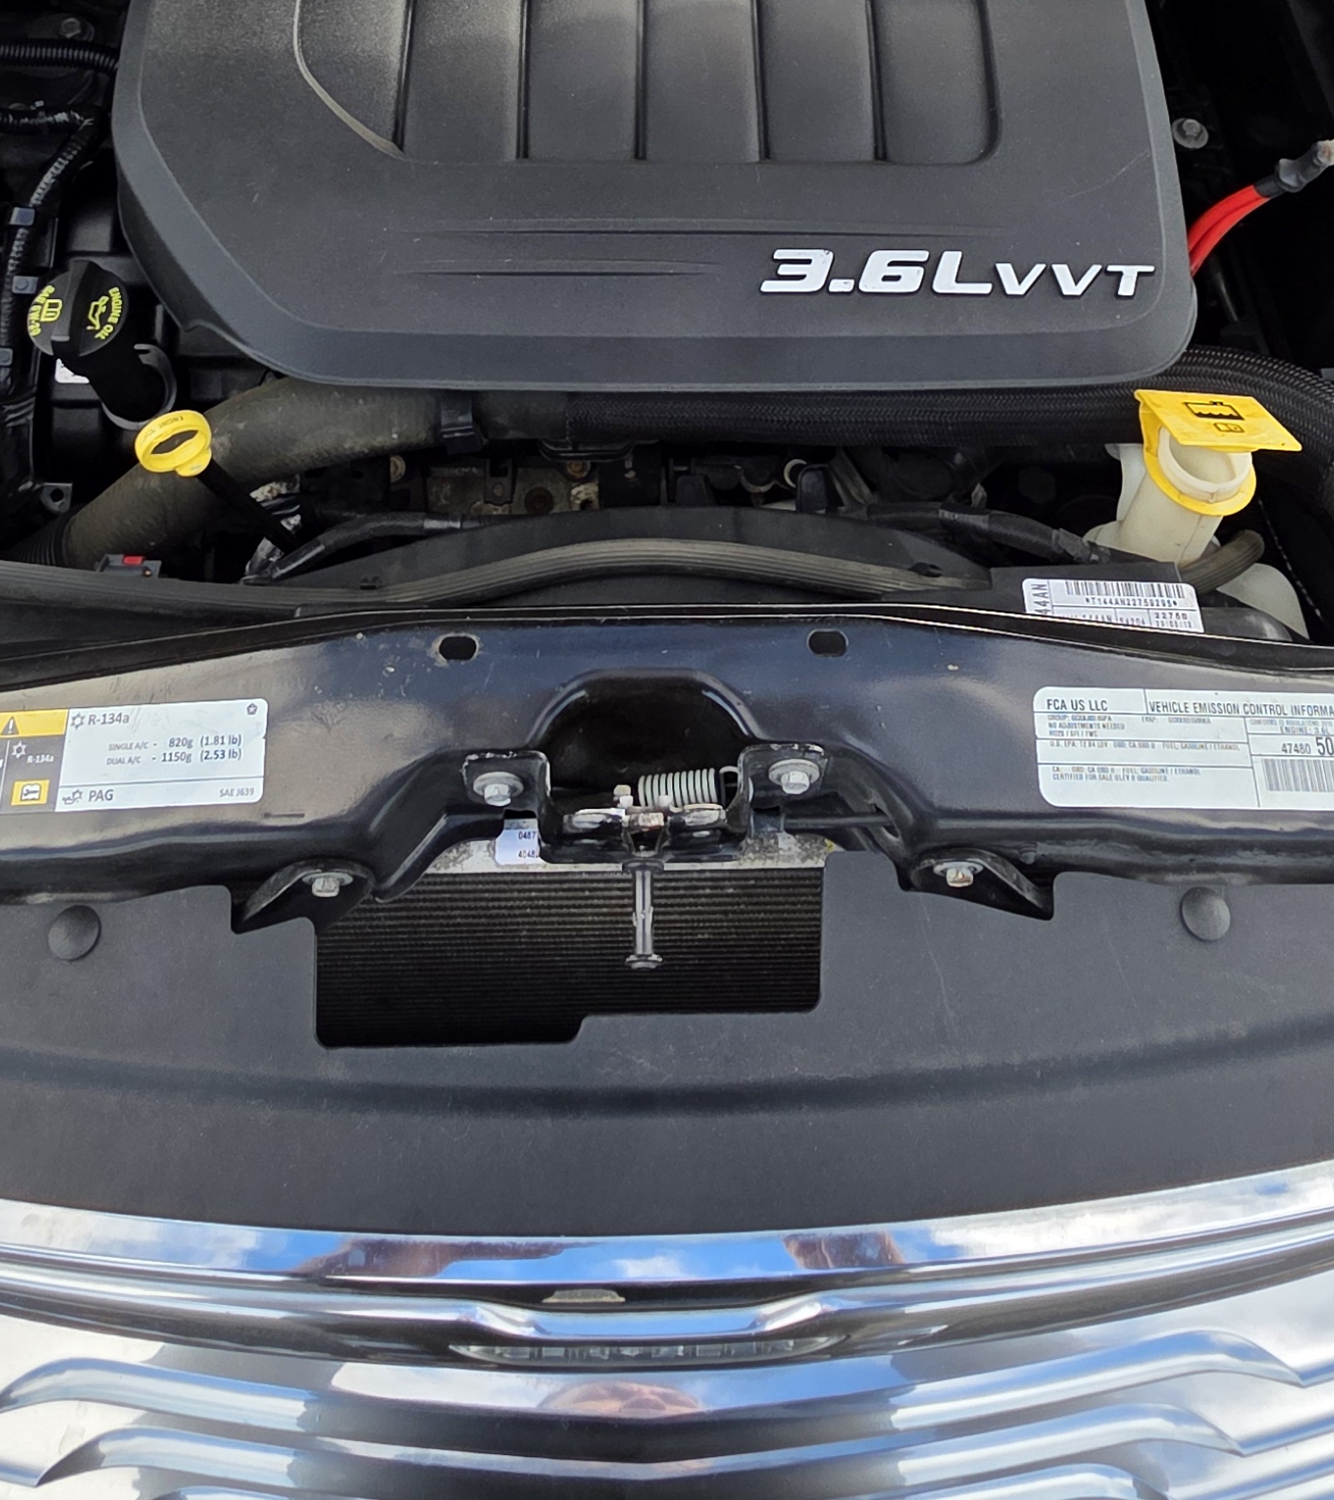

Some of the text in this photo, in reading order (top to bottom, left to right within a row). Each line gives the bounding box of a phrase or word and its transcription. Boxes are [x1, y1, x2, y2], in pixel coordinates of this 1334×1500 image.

[759, 248, 1156, 297] 3.6L VVT
[93, 286, 123, 341] ENGINE OIL
[1046, 698, 1108, 712] FCA US LLC
[1148, 701, 1190, 713] VEHICLE
[1192, 702, 1240, 715] EMISSION
[1242, 703, 1288, 716] CONTROL
[87, 712, 130, 726] R-134a
[108, 742, 133, 751] SINGLE
[134, 741, 149, 751] A/C
[168, 737, 194, 749] 820g
[199, 735, 226, 748] (1.81
[228, 734, 242, 747] lb)
[1281, 742, 1312, 754] 47480
[26, 754, 54, 764] R-134a
[106, 756, 127, 766] DUAL
[127, 755, 142, 765] A/C
[161, 751, 193, 763] 1150g
[199, 749, 226, 762] (2.53
[228, 748, 242, 761] lb)
[87, 788, 114, 802] PAG
[219, 787, 255, 798] SAE J639
